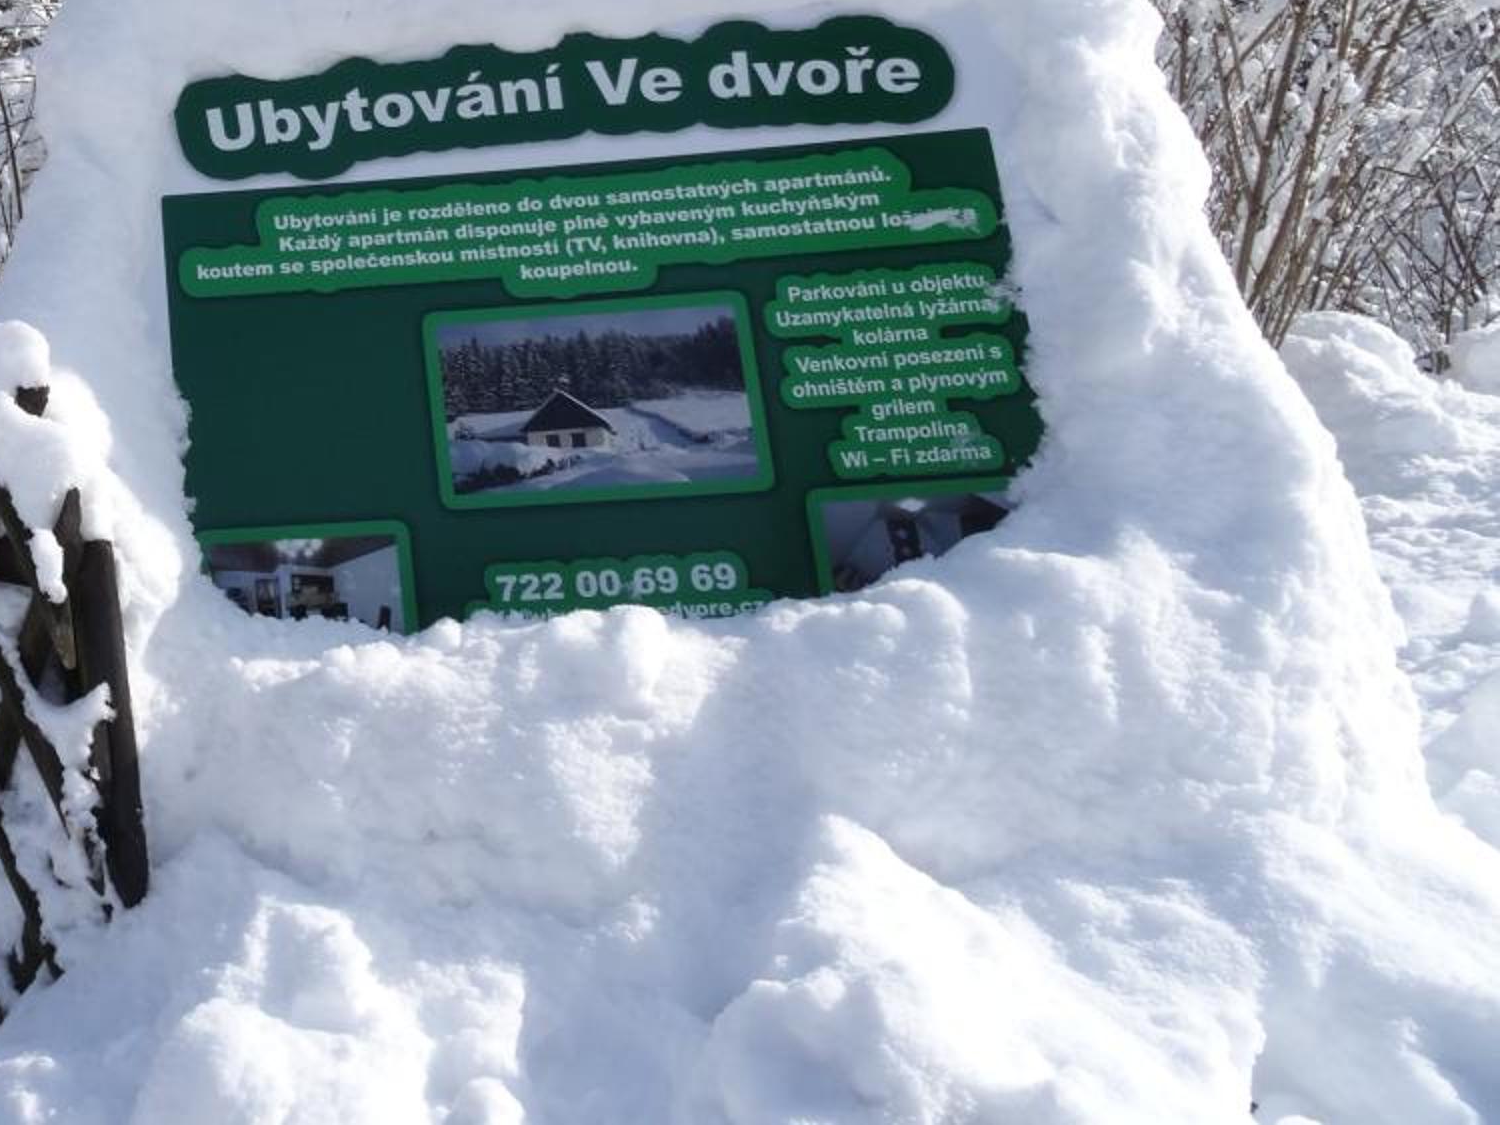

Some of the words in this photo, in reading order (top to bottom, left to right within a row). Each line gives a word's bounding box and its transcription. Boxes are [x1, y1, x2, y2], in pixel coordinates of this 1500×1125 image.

[205, 63, 566, 152] Ubytování
[586, 58, 683, 106] Ve
[708, 46, 922, 100] dvoře
[273, 208, 377, 232] Ubytování
[382, 207, 402, 225] je
[408, 197, 511, 221] rozděleno
[517, 195, 543, 212] do
[549, 192, 600, 210] dvou
[606, 177, 758, 205] samostatných
[764, 165, 892, 194] apartmánů.
[279, 234, 341, 253] Každý
[347, 223, 449, 249] apartmán
[455, 217, 557, 242] disponuje
[563, 212, 610, 233] plně
[615, 203, 735, 229] vybaveným
[742, 192, 880, 217] kuchyňským
[197, 260, 274, 280] koutem
[279, 259, 305, 274] se
[311, 249, 453, 275] společenskou
[460, 238, 559, 261] místností
[566, 235, 607, 257] (TV,
[613, 227, 725, 250] knihovna),
[731, 212, 875, 241] samostatnou
[520, 259, 638, 280] koupelnou.
[788, 279, 887, 302] Parkování
[892, 281, 905, 294] u
[910, 273, 985, 295] objektu
[776, 302, 914, 327] Uzamykatelná
[853, 326, 929, 346] kolárna
[795, 351, 888, 374] Venkovní
[894, 345, 985, 369] posezení
[990, 346, 1002, 359] s
[792, 376, 886, 398] ohništěm
[891, 379, 903, 391] a
[909, 367, 1009, 393] plynovým
[871, 399, 935, 420] grilem
[854, 420, 968, 443] Trampolína
[841, 450, 868, 468] Wi
[891, 449, 911, 465] Fi
[916, 443, 993, 464] zdarma
[496, 573, 565, 602] 722
[575, 569, 621, 597] 00
[633, 565, 678, 594] 69
[691, 563, 738, 591] 69
